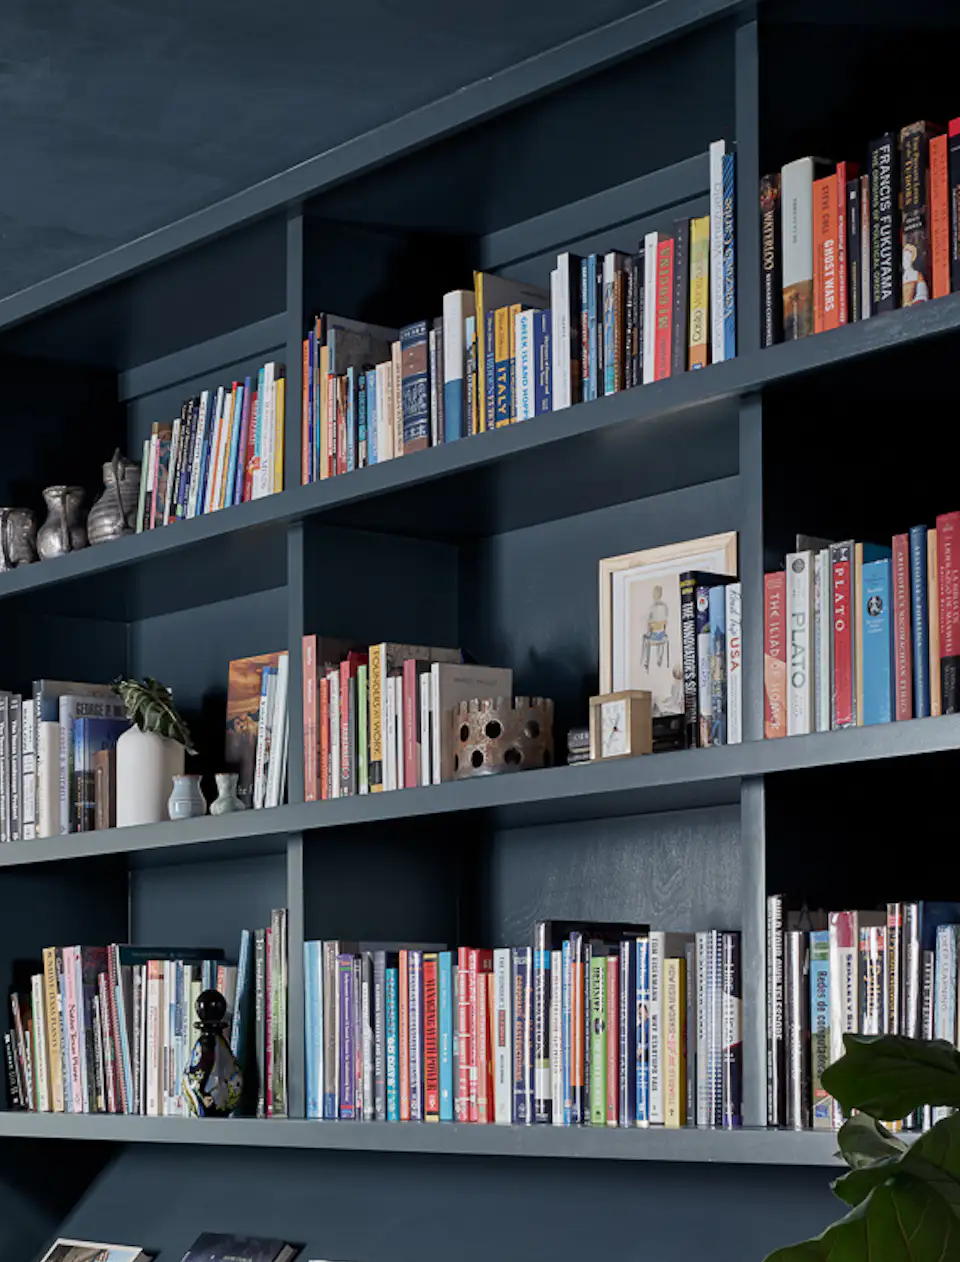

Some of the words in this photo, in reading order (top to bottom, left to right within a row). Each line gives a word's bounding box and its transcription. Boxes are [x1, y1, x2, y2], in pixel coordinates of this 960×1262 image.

[879, 144, 891, 212] FRANCIS
[763, 210, 774, 271] WATERLOO
[824, 239, 834, 276] GHOST
[880, 215, 892, 301] FUKUYAMA
[659, 246, 670, 305] COCINA
[824, 277, 834, 312] WARS
[658, 308, 668, 330] MI
[497, 367, 507, 414] ITALY
[682, 602, 693, 620] THE
[769, 593, 780, 620] THE
[834, 567, 844, 633] PLATO
[730, 637, 739, 672] USA
[770, 622, 780, 660] ILIAD
[791, 612, 806, 689] PLATO
[372, 651, 381, 708] FOUNDERS
[373, 721, 381, 755] WORK
[941, 935, 949, 959] DEEP
[816, 970, 827, 998] Redes
[941, 962, 949, 1012] LEARNING
[427, 979, 436, 1027] MANAGING
[817, 1001, 827, 1012] de
[427, 1027, 436, 1054] WITH
[816, 1015, 827, 1079] computadoras
[427, 1058, 436, 1091] POWER
